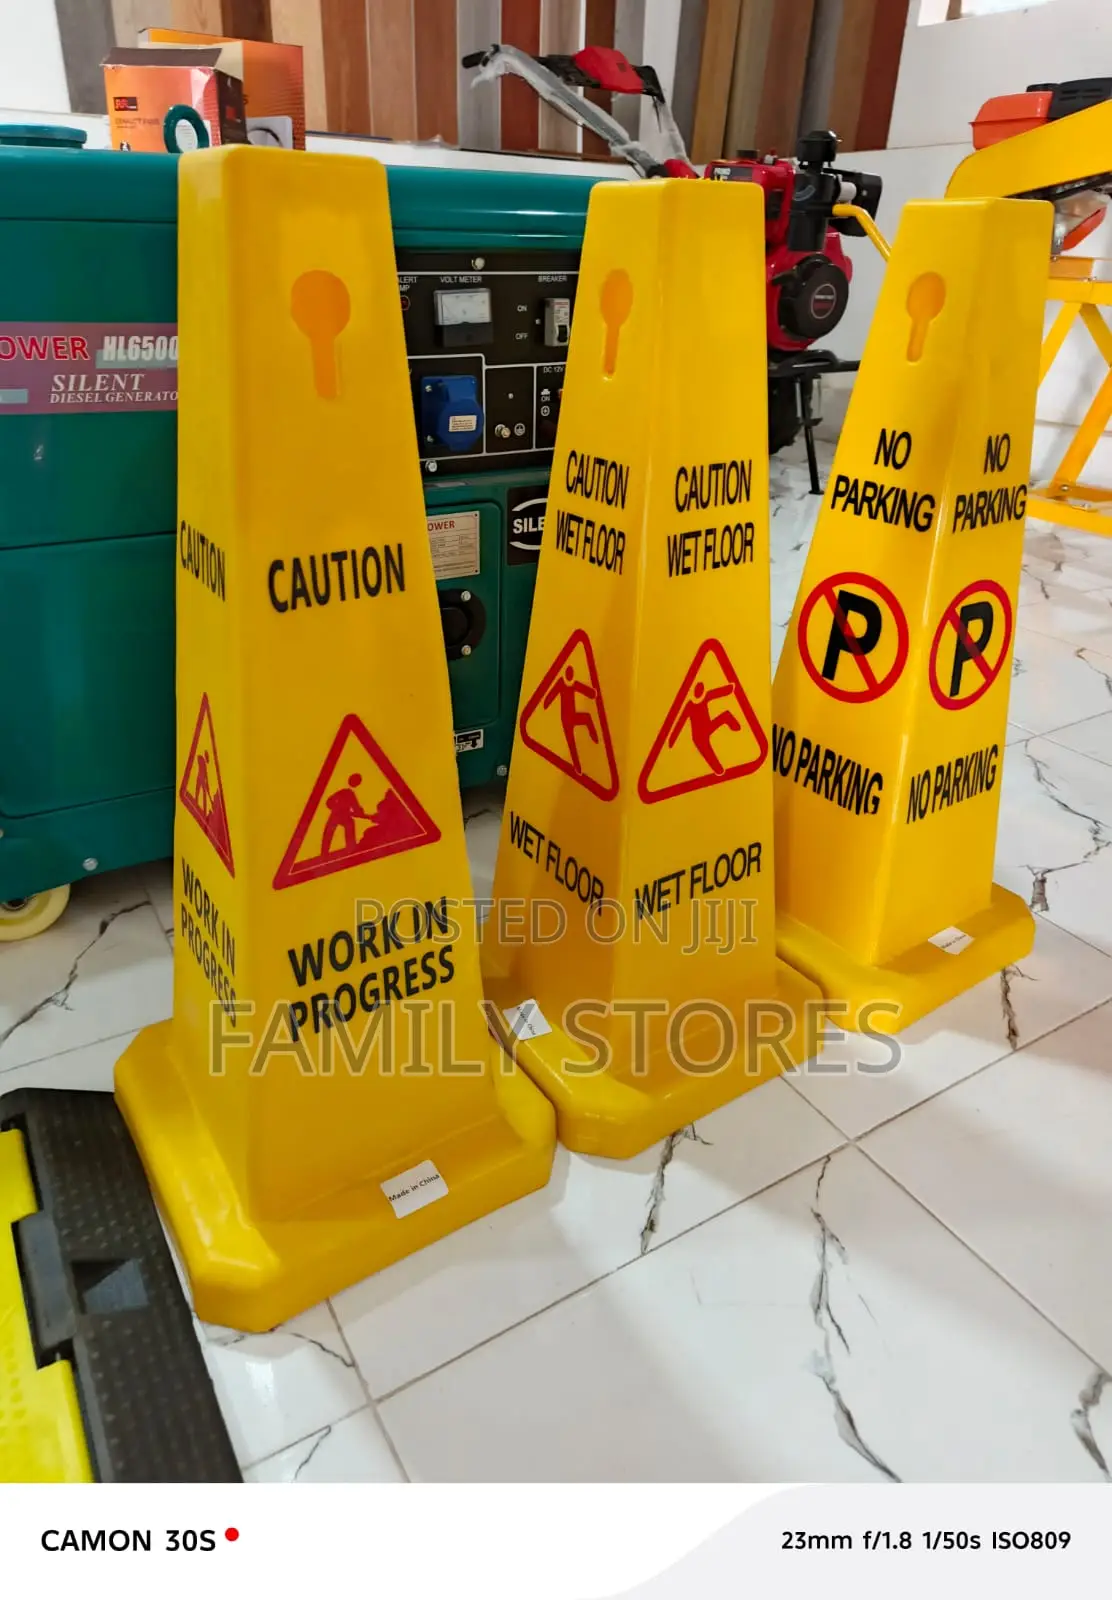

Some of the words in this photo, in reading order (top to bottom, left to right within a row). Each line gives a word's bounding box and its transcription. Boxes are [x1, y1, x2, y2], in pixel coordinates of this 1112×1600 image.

[459, 275, 482, 283] METER
[50, 392, 103, 404] DIESEL
[51, 373, 145, 392] SILENT
[566, 450, 629, 510] CAUTION
[874, 428, 912, 470] NO
[983, 433, 1011, 474] NO
[675, 459, 752, 512] CAUTION
[830, 475, 935, 532] PARKING
[952, 483, 1027, 534] PARKING
[180, 519, 226, 602] CAUTION
[556, 509, 583, 556] WET
[583, 519, 626, 575] FLOOR
[667, 531, 702, 578] WET
[703, 522, 755, 571] FLOOR
[268, 543, 405, 613] CAUTION
[772, 723, 796, 781] NO
[796, 736, 883, 816] PARKING
[906, 769, 932, 825] NO
[931, 743, 999, 813] PARKING
[509, 811, 545, 865] WET
[546, 840, 605, 917] FLOOR
[634, 869, 685, 920] WET
[689, 841, 762, 900] FLOOR
[181, 856, 219, 949] WORK
[222, 920, 235, 977] IN
[287, 911, 404, 987] WORK
[412, 896, 449, 944] IN
[181, 903, 236, 1028] PROGRESS
[288, 945, 455, 1043] PROGRESS
[388, 1189, 410, 1202] Made
[419, 1174, 440, 1187] China
